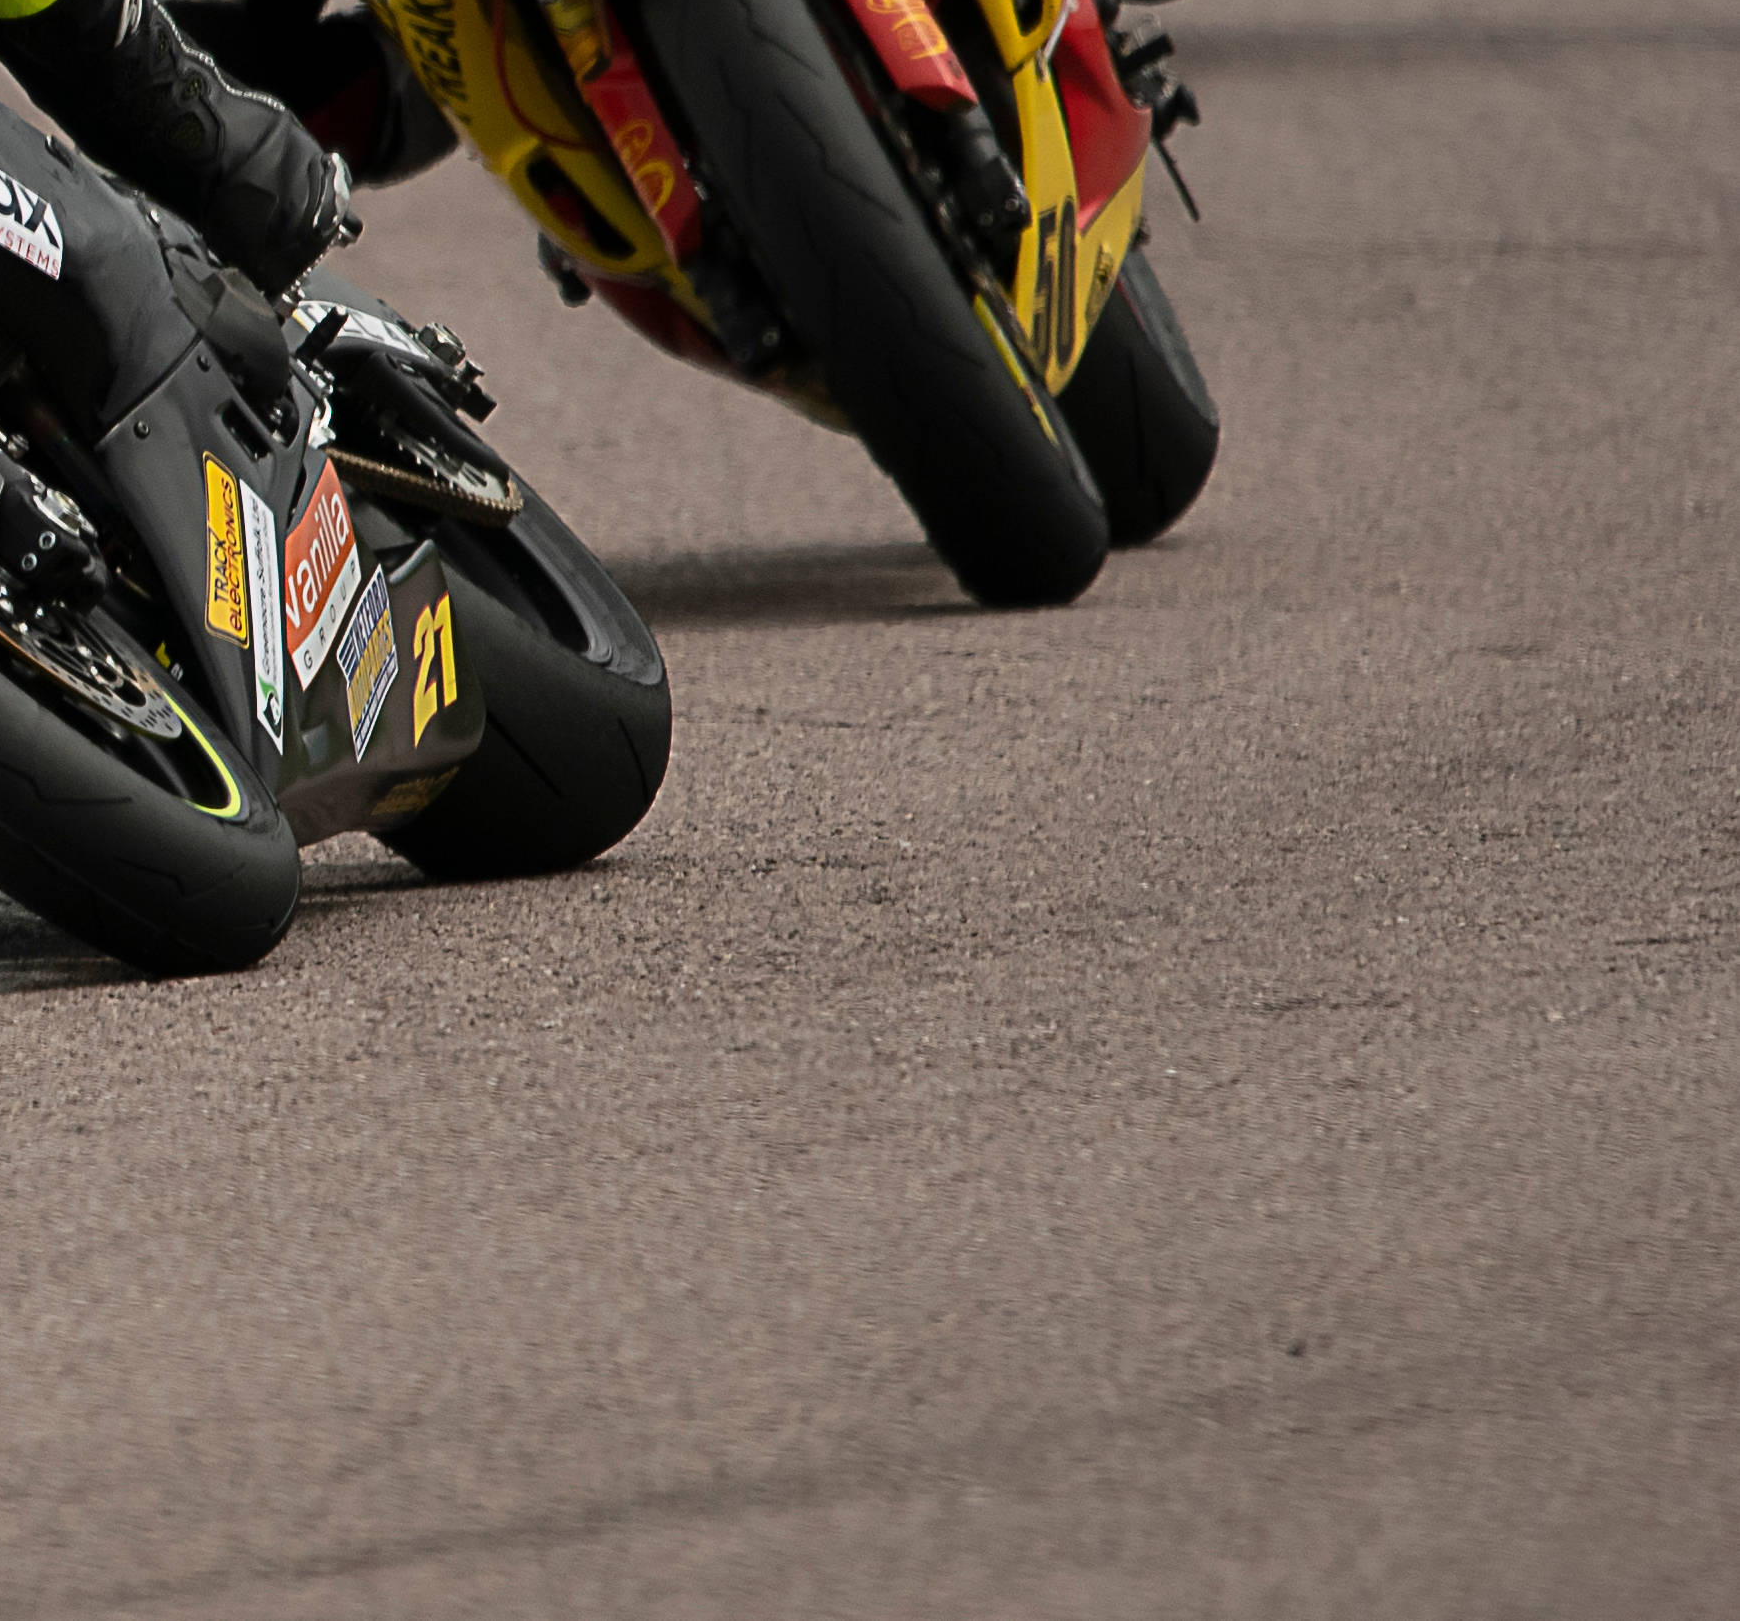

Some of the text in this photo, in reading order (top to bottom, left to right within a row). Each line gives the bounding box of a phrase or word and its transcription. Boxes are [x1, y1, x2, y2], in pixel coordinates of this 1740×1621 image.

[213, 536, 229, 603] TRACK
[285, 491, 350, 629] vanilla
[303, 557, 358, 671] GROUP
[413, 590, 458, 750] 21
